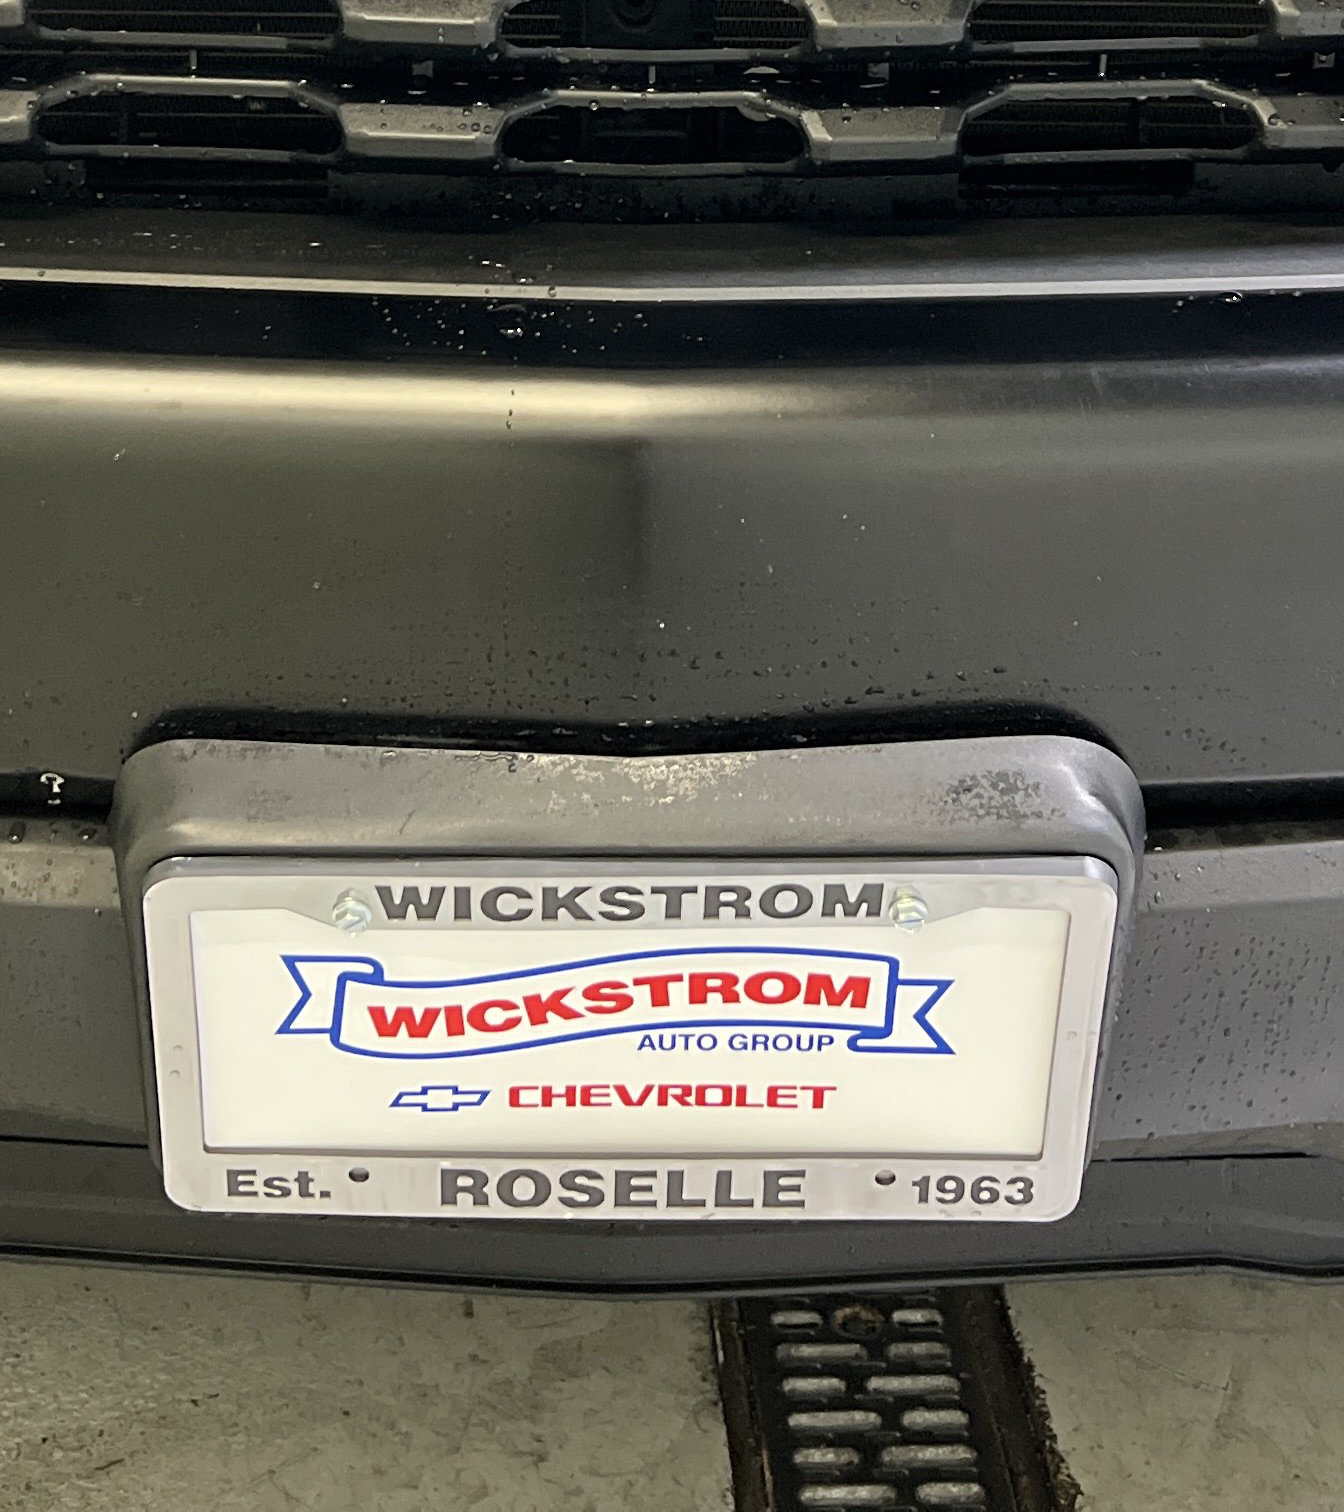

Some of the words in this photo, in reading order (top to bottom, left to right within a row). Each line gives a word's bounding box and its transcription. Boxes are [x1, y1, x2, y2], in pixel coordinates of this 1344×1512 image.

[374, 881, 885, 922] WICKSTROM
[366, 971, 871, 1039] WICKSTROM
[636, 1034, 718, 1052] AUTO
[727, 1033, 834, 1052] GROUP
[507, 1084, 838, 1110] CHEVROLET
[224, 1169, 331, 1199] Est.
[438, 1168, 808, 1209] ROSELLE
[910, 1173, 1035, 1208] 1963
